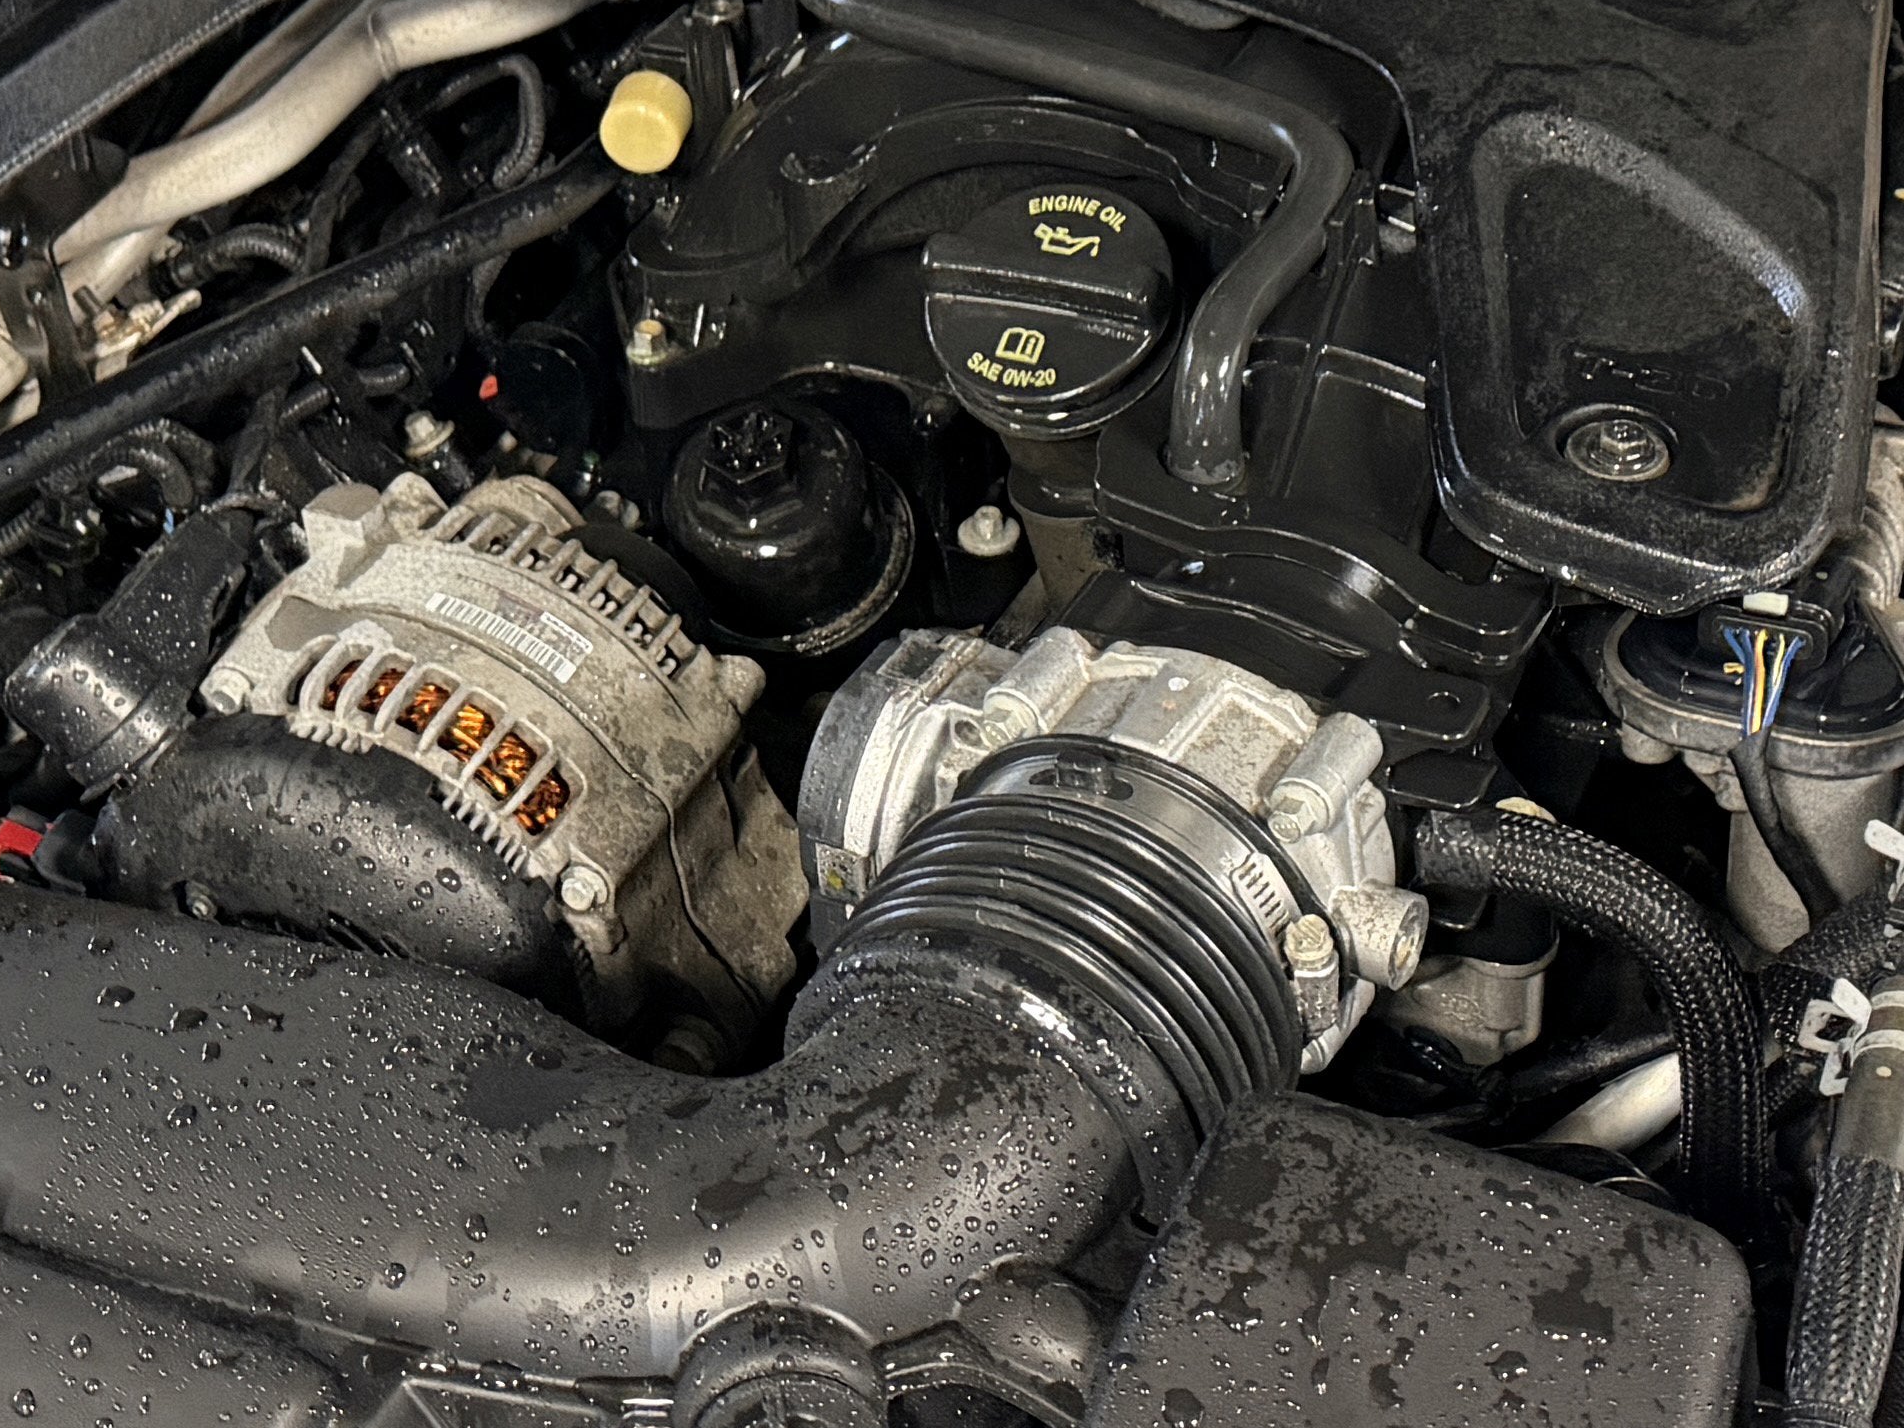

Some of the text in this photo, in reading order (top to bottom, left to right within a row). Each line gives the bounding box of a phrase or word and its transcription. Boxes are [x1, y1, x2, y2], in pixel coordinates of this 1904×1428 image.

[1028, 195, 1127, 234] ENGINE OIL
[967, 352, 1056, 388] SAE 0W-20
